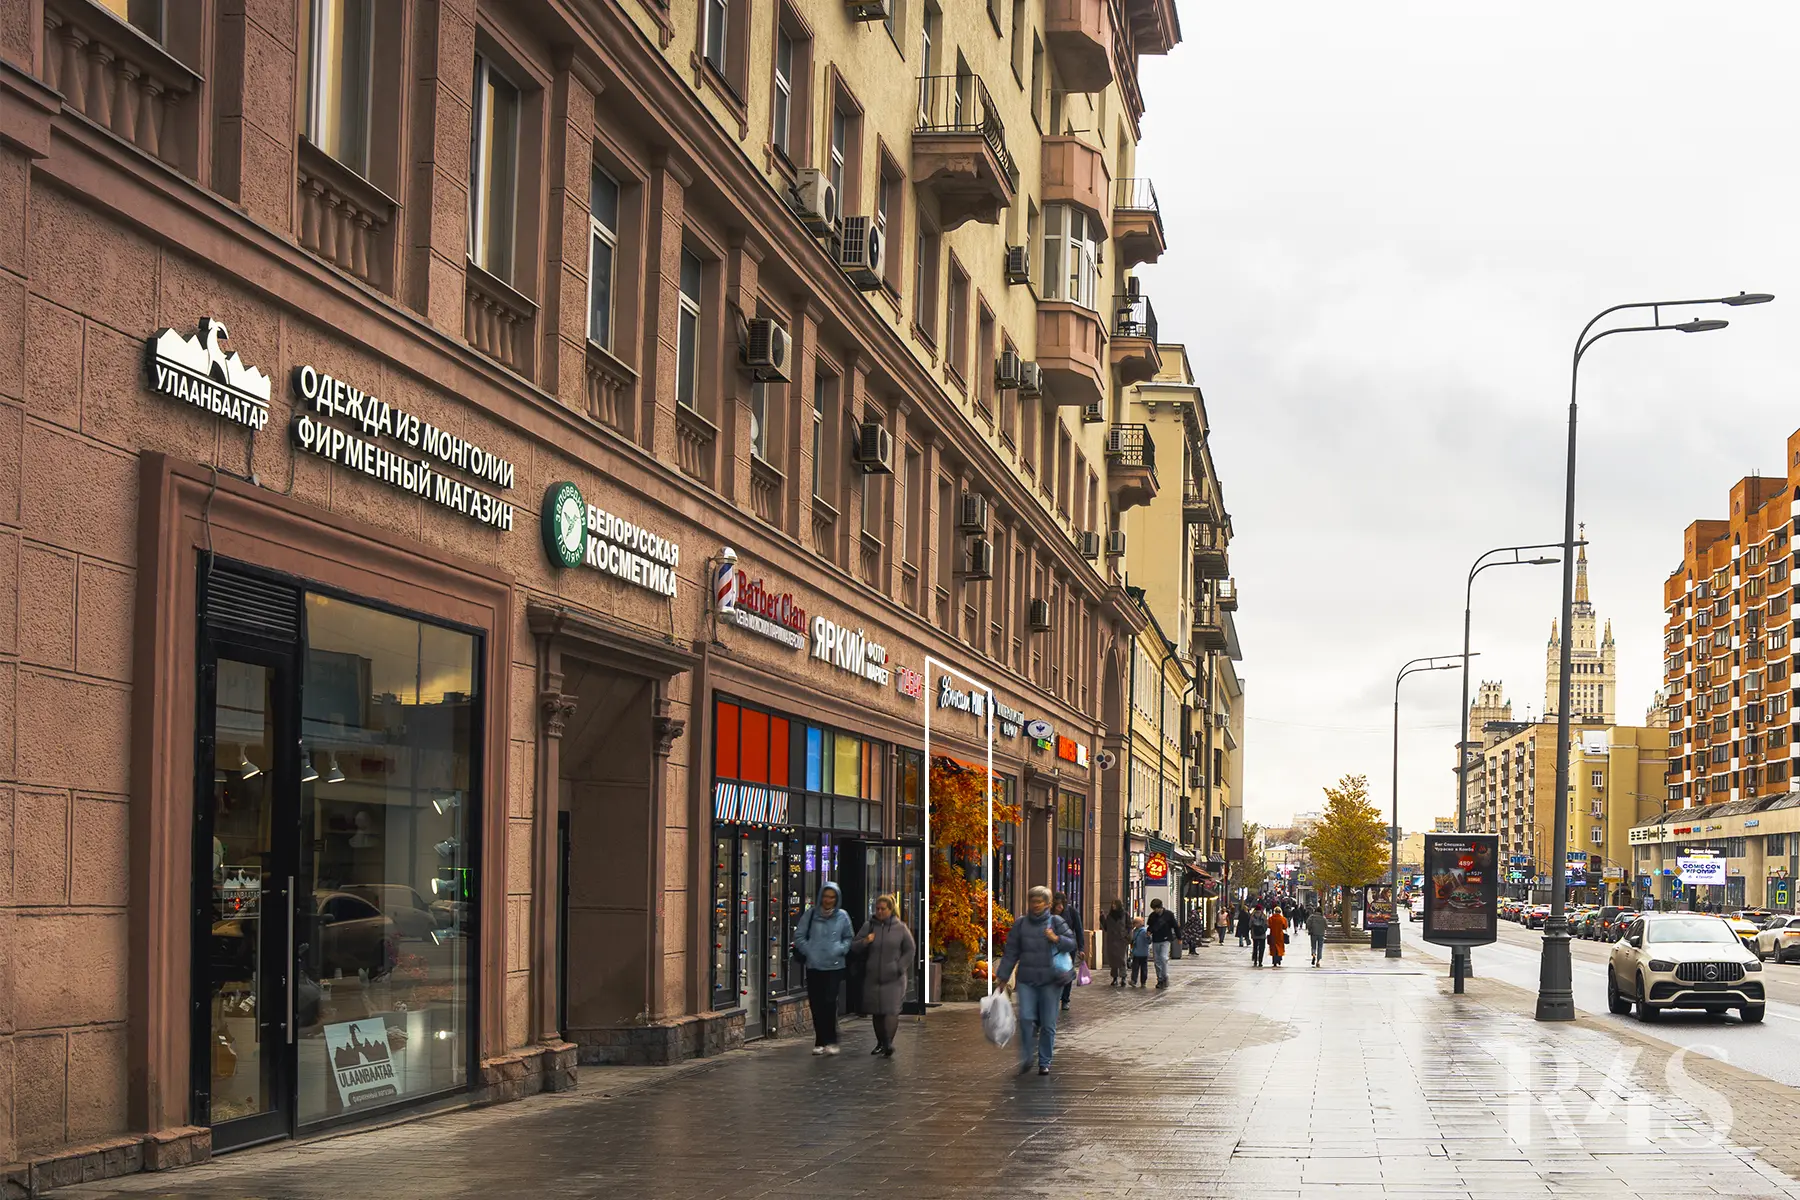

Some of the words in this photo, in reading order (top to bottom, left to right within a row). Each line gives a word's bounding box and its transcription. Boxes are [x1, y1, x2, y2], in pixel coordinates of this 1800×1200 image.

[155, 364, 269, 431] УЛААНБААТАР
[300, 365, 392, 437] ОДЕЖДА
[396, 409, 420, 446] ИЗ
[423, 423, 515, 489] МОНГОЛИИ
[298, 416, 431, 500] ФИРМЕННЫЙ
[435, 477, 513, 531] МАГАЗИН
[587, 504, 679, 567] БЕЛОРУССКАЯ
[587, 534, 678, 598] КОСМЕТИКА
[737, 570, 779, 620] Barber
[781, 593, 807, 635] Clan
[815, 615, 865, 677] ЯРКИЙ
[866, 661, 889, 686] МАРКЕТ
[867, 641, 886, 665] ФОТО
[1151, 864, 1162, 872] 24
[338, 1064, 394, 1088] ULAANBAATAR
